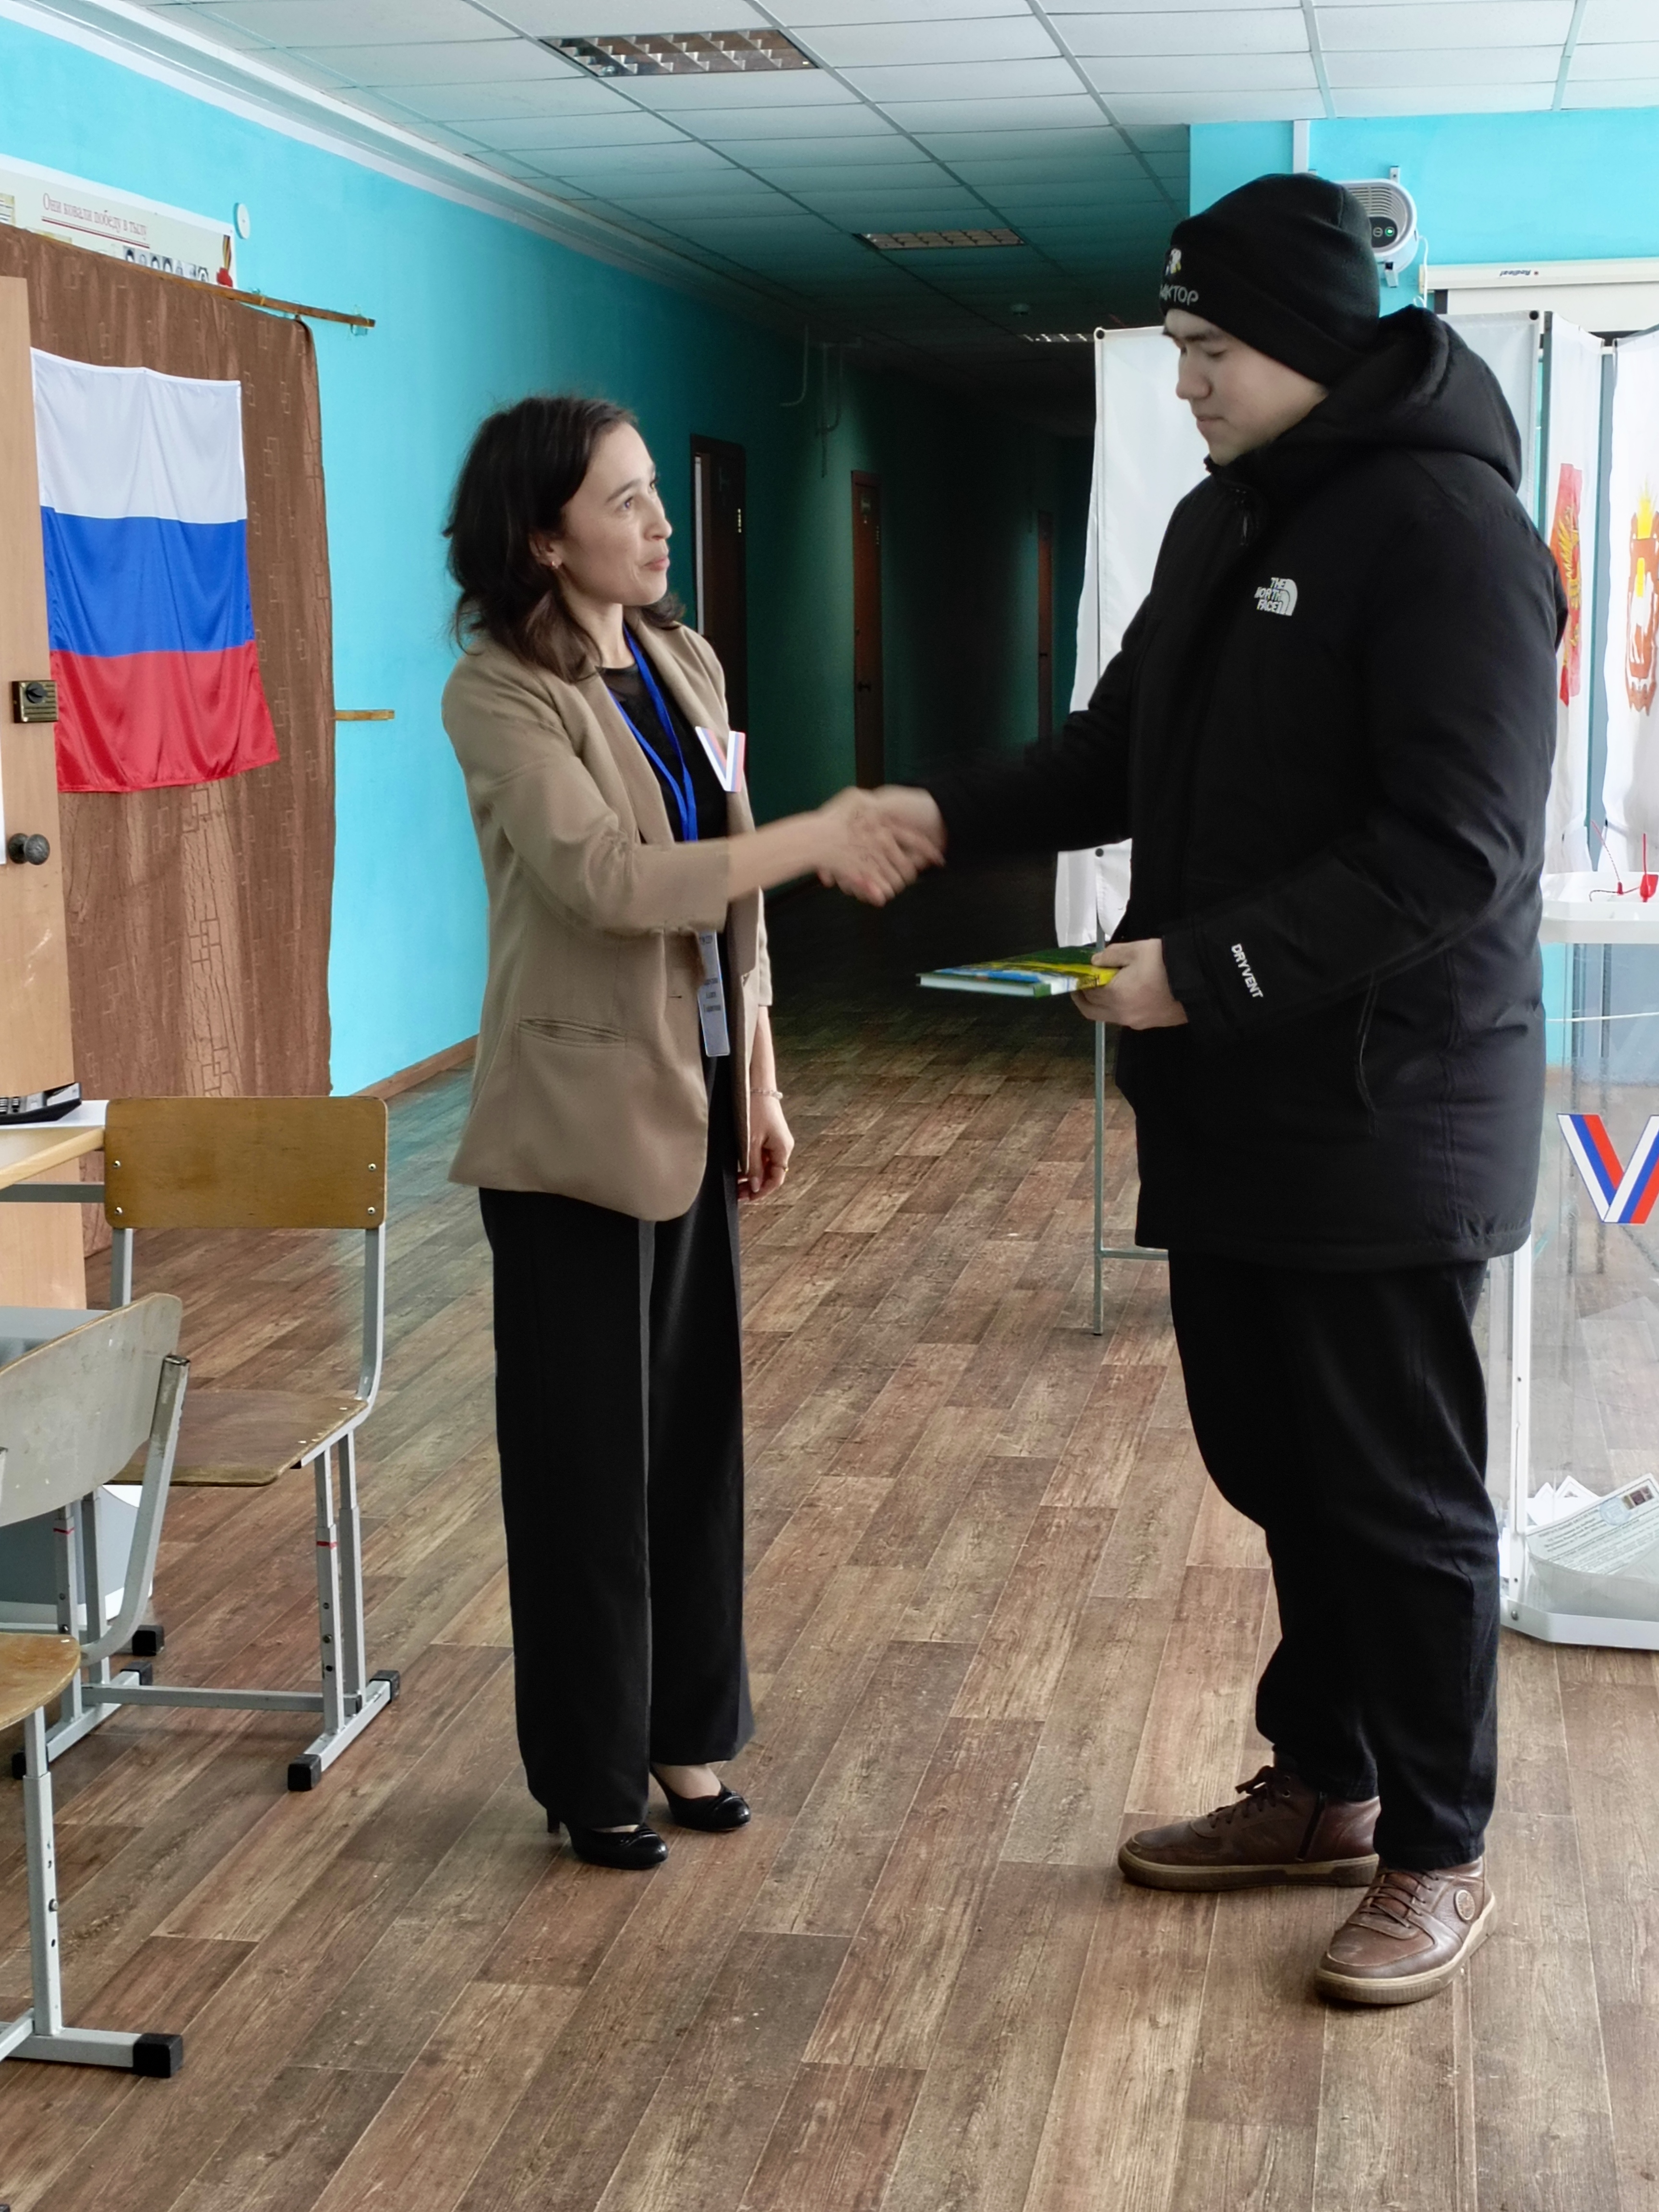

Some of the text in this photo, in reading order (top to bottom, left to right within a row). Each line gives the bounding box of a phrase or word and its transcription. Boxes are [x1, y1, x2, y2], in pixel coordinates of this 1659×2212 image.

[43, 192, 61, 214] Они
[1270, 577, 1286, 589] THE
[1256, 599, 1278, 613] FACE
[1231, 943, 1264, 998] DRYVENT
